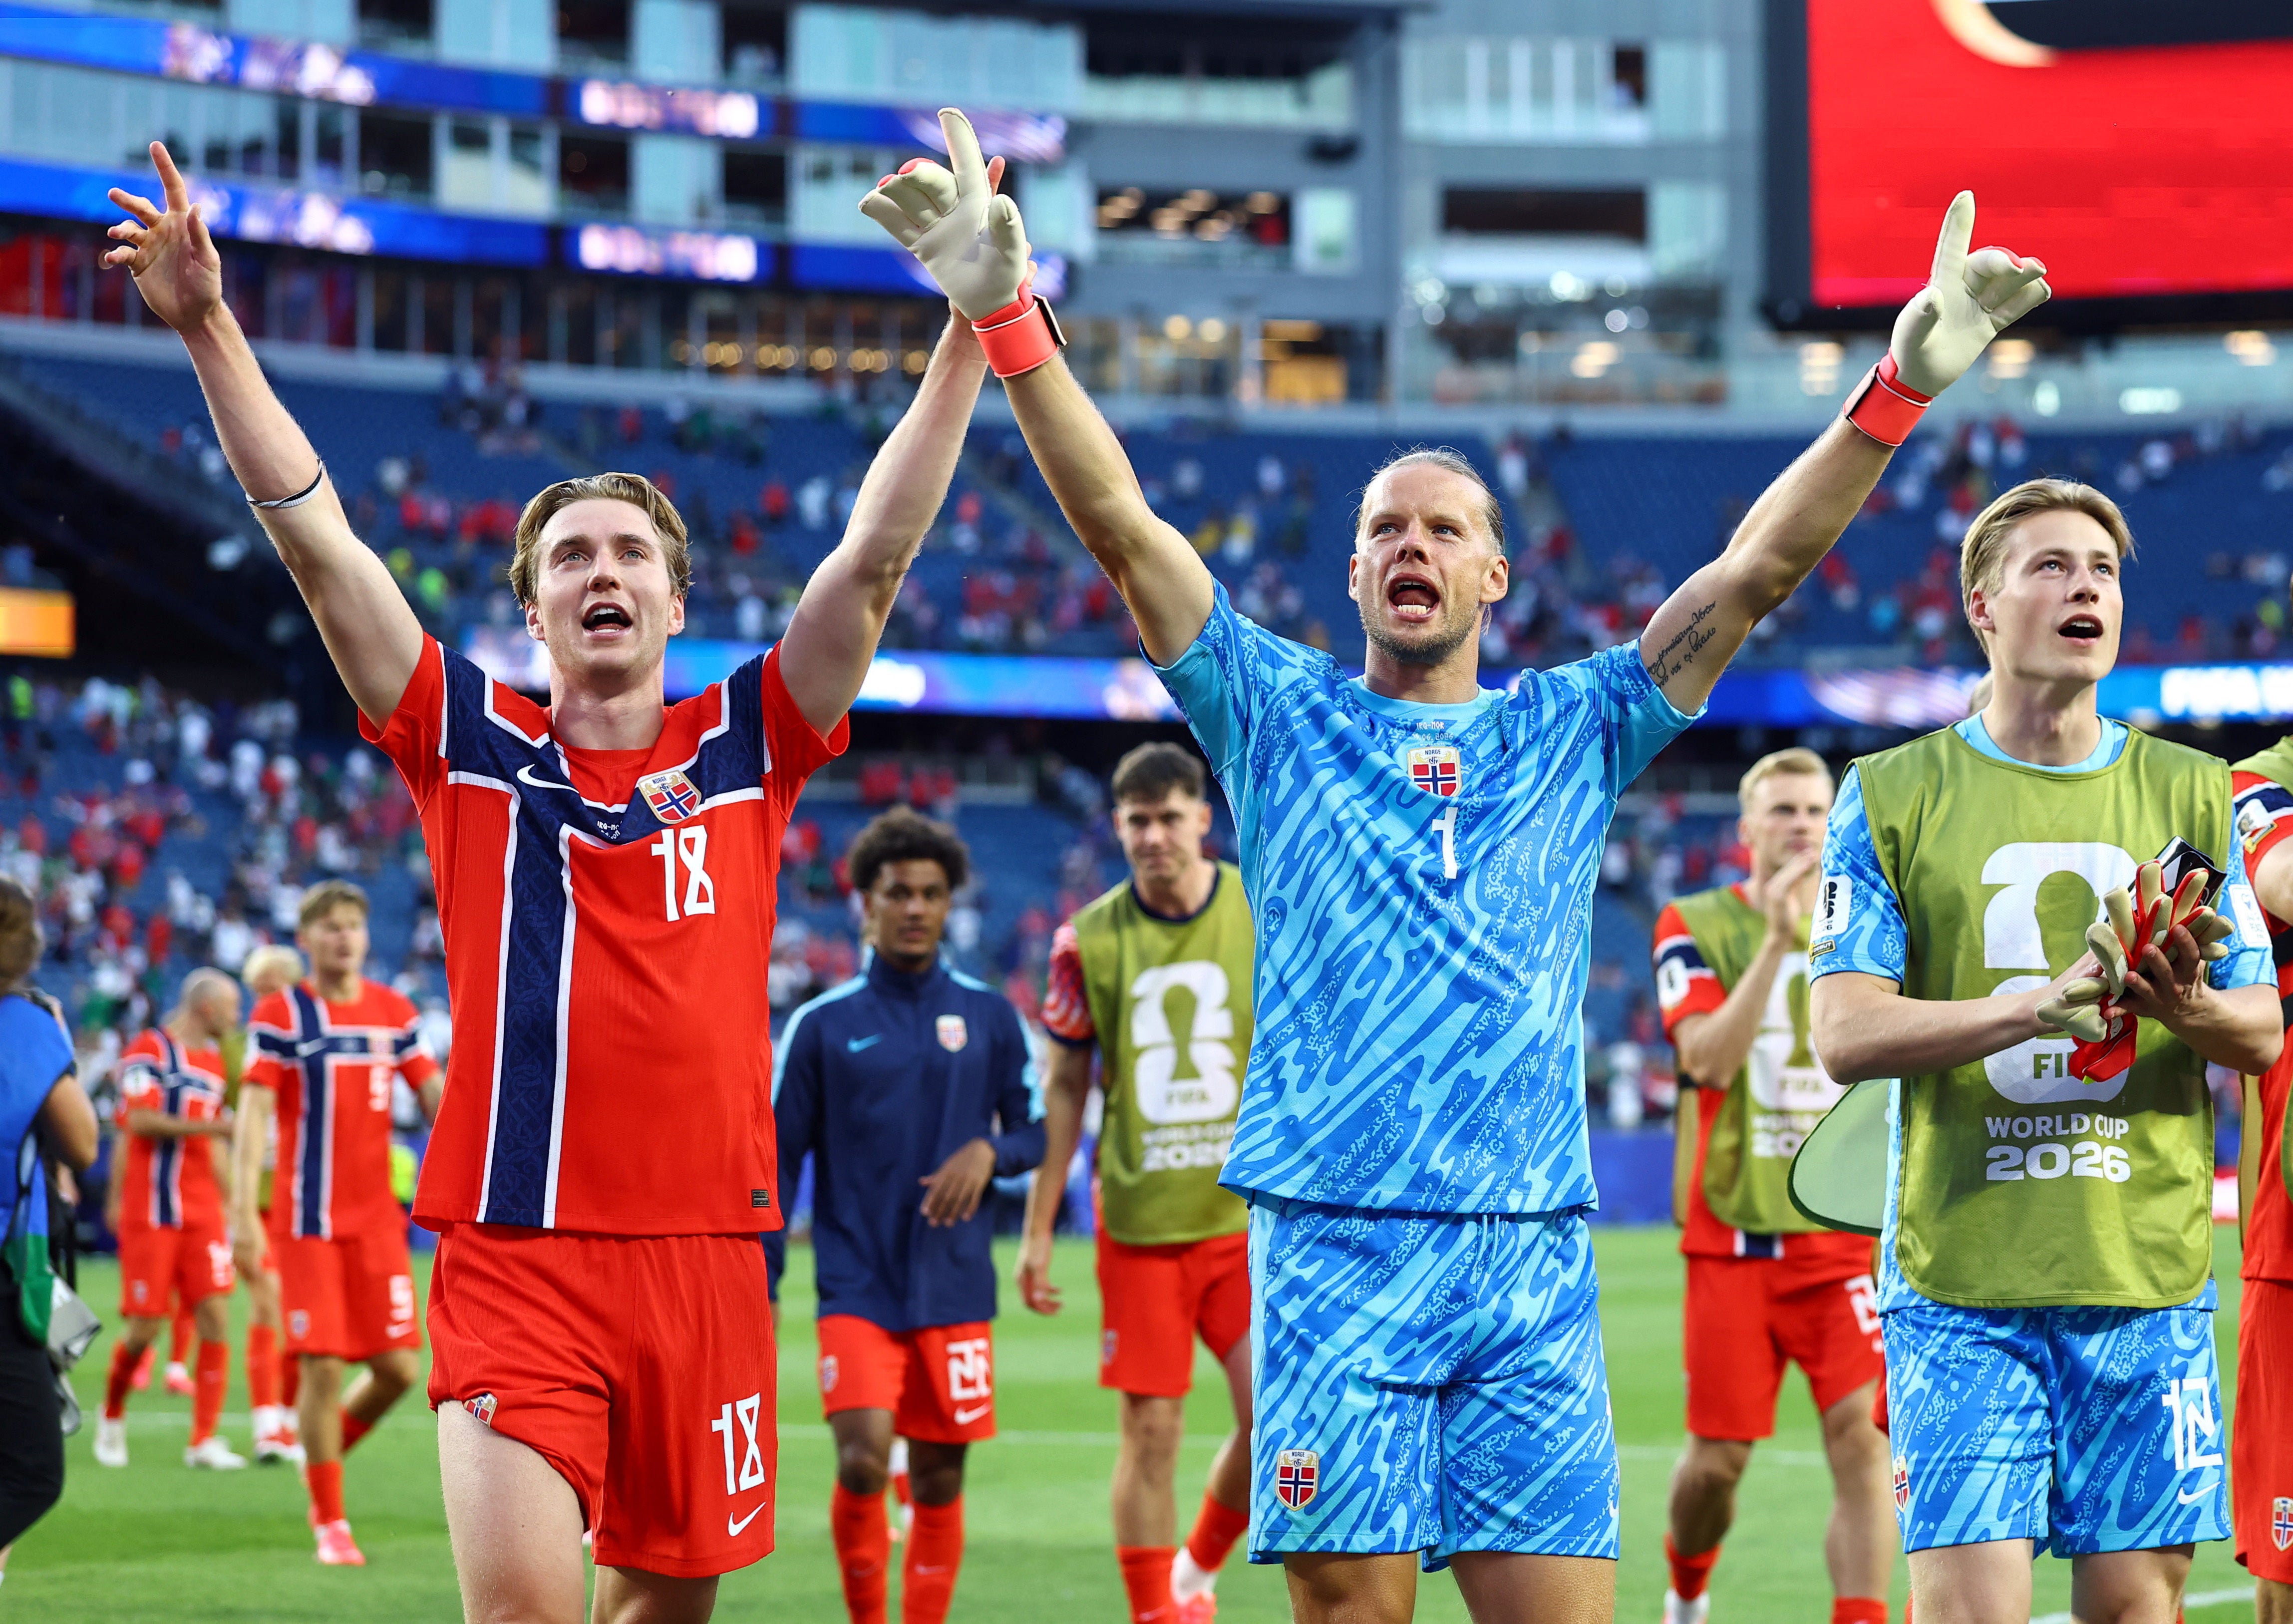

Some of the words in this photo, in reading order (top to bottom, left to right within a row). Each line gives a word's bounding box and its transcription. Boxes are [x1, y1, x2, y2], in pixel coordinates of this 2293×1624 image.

[1416, 721, 1444, 730] IRQ-NOR
[652, 775, 667, 784] NORGE
[1431, 806, 1458, 879] 1
[651, 825, 716, 922] 18
[1813, 942, 1832, 953] DEBUT
[2033, 1052, 2072, 1079] FI
[1985, 1113, 2091, 1138] WORLD
[2094, 1114, 2130, 1140] CUP
[1986, 1140, 2131, 1183] 2026
[2162, 1376, 2224, 1471] 12
[711, 1391, 766, 1496] 18
